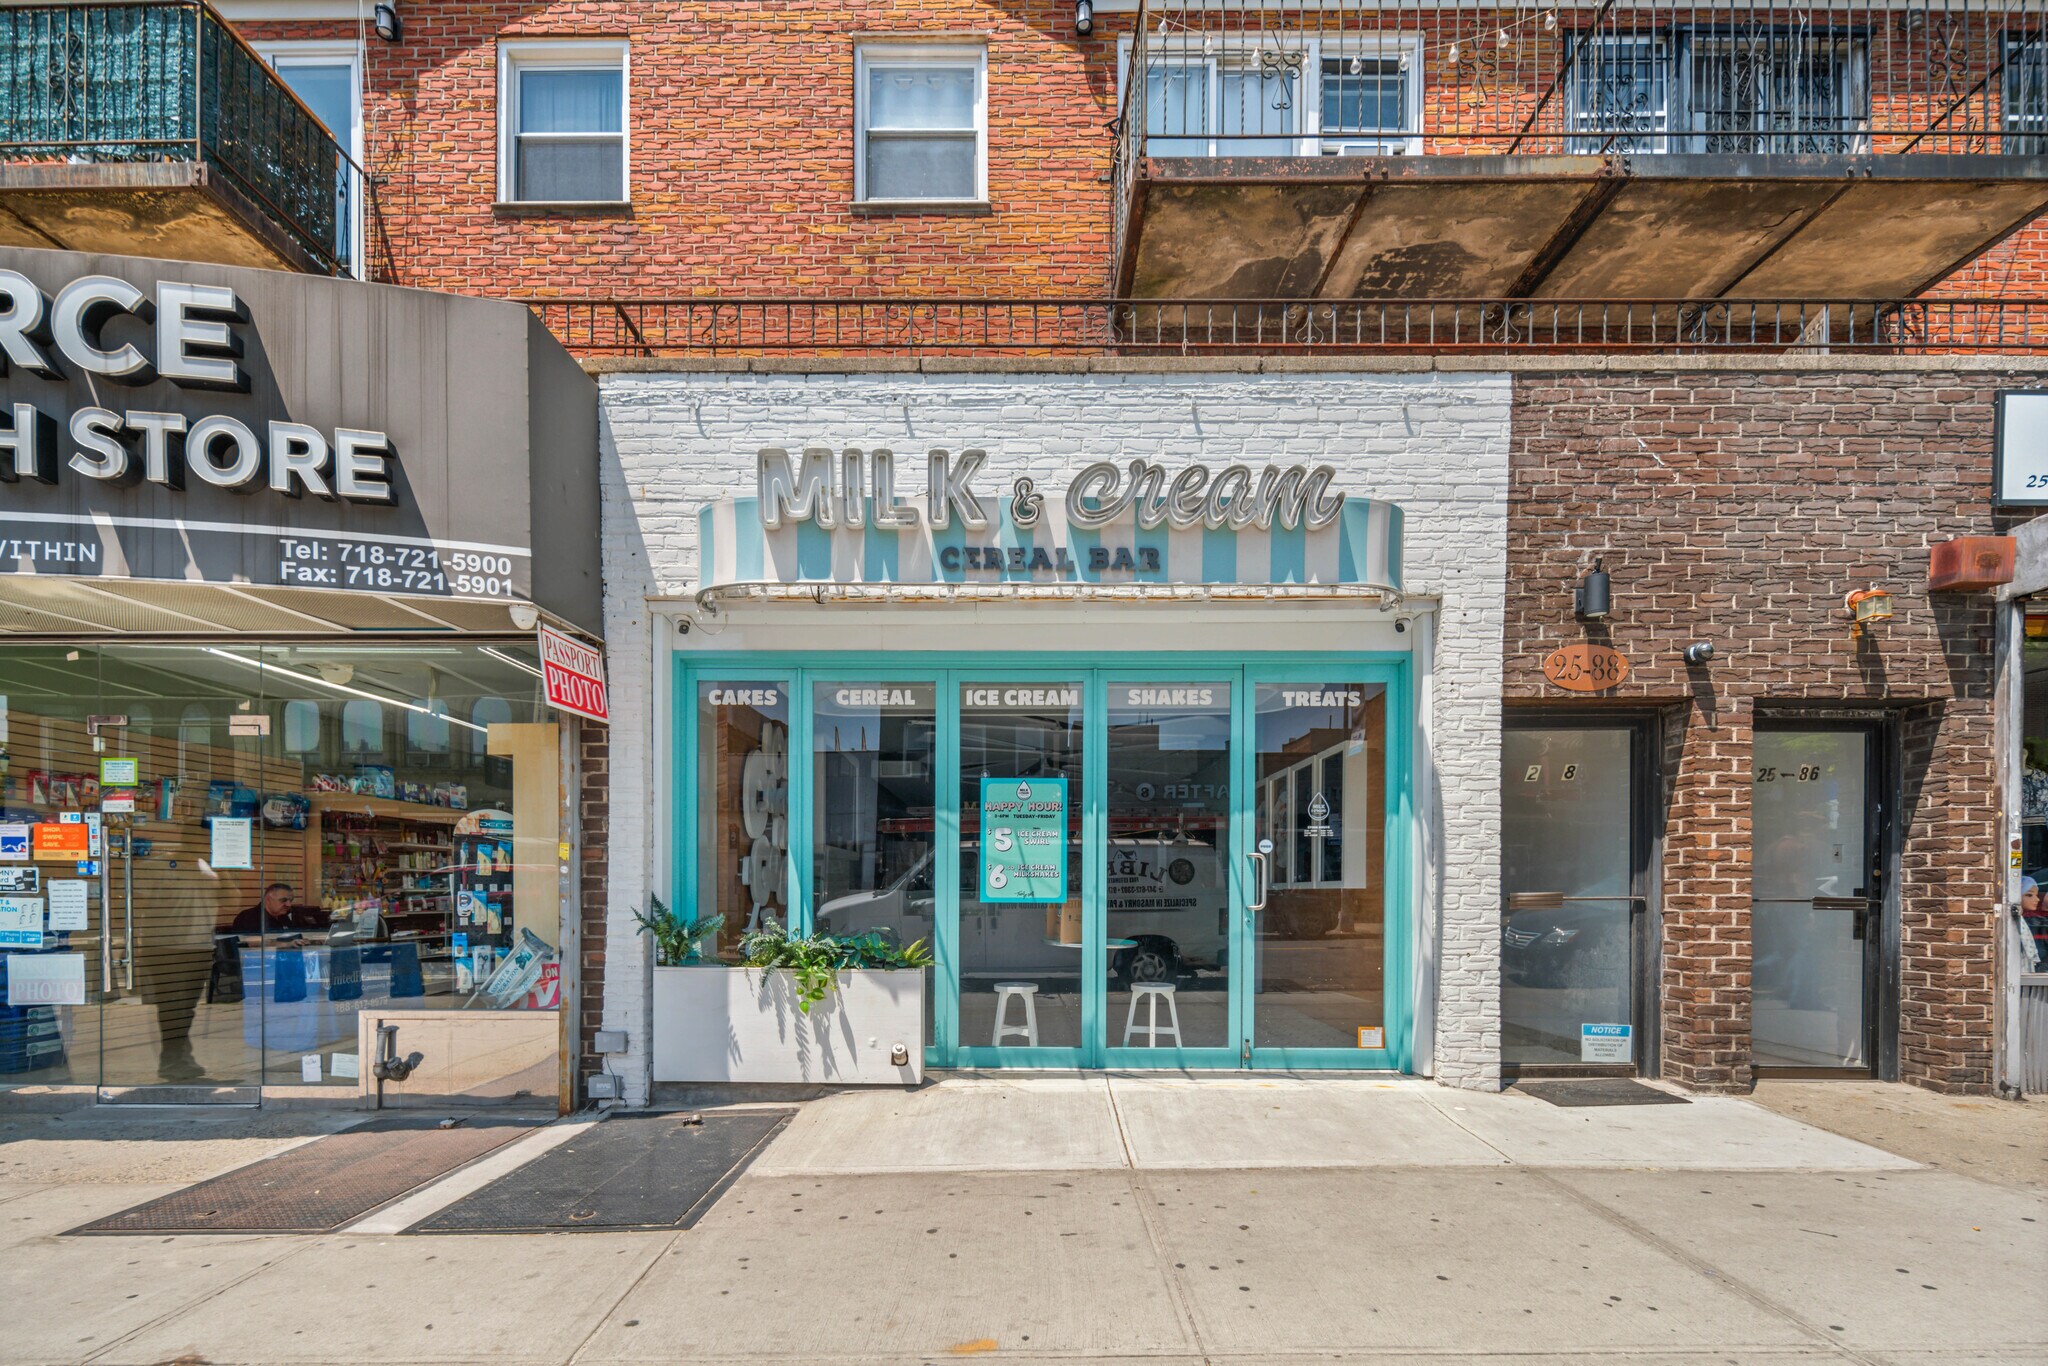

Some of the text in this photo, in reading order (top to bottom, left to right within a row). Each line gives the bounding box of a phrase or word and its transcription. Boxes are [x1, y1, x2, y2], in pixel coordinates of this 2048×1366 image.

[68, 407, 395, 500] STORE
[757, 448, 988, 531] MILK
[1011, 476, 1045, 530] &
[0, 540, 96, 562] ITHIN
[280, 539, 512, 575] Tel: 718-721-5900
[940, 546, 1161, 571] CEREAL BAR
[280, 561, 513, 596] Fax: 718-721-5901
[545, 635, 598, 678] PASSPORT
[1554, 654, 1620, 681] 25-88
[548, 665, 605, 714] PHOTO
[708, 689, 778, 706] CAKES
[836, 689, 916, 706] CEREAL
[966, 690, 1079, 706] ICE CREAM
[1128, 689, 1213, 706] SHAKES
[1282, 691, 1361, 708] TREATS
[1564, 765, 1577, 780] 8
[984, 801, 1063, 812] HAPPY HOUR!
[1031, 830, 1058, 838] CREAM
[15, 982, 78, 1000] PHOTO
[1591, 1026, 1622, 1035] NOTICE
